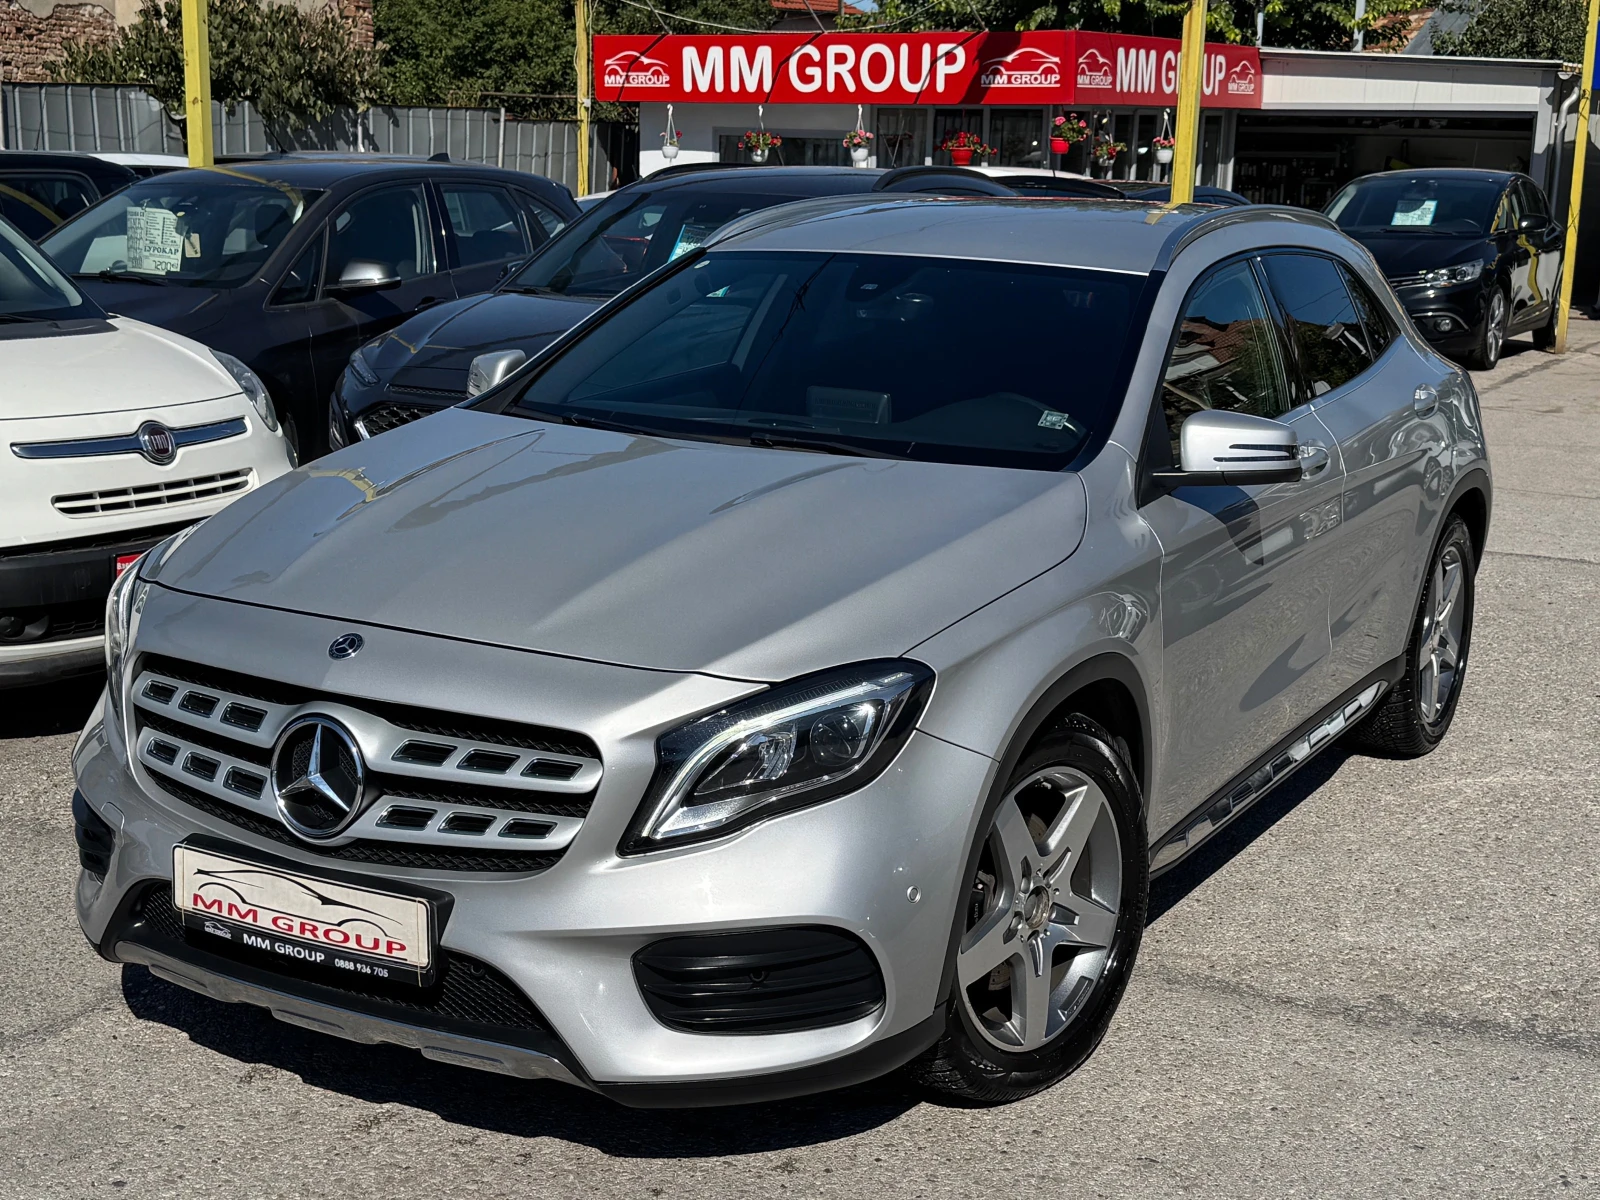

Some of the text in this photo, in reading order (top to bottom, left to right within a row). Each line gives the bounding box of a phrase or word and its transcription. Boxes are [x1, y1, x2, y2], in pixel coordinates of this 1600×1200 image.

[604, 75, 670, 85] MM GROUP
[682, 43, 966, 93] MM GROUP
[981, 73, 1061, 85] MM GROUP
[1077, 74, 1113, 86] MM GROUP
[1116, 47, 1227, 96] MM GUP
[192, 893, 407, 954] MM GROUP
[243, 933, 271, 951] MM
[275, 942, 325, 963] GROUP
[334, 957, 389, 978] 0888 936 705
